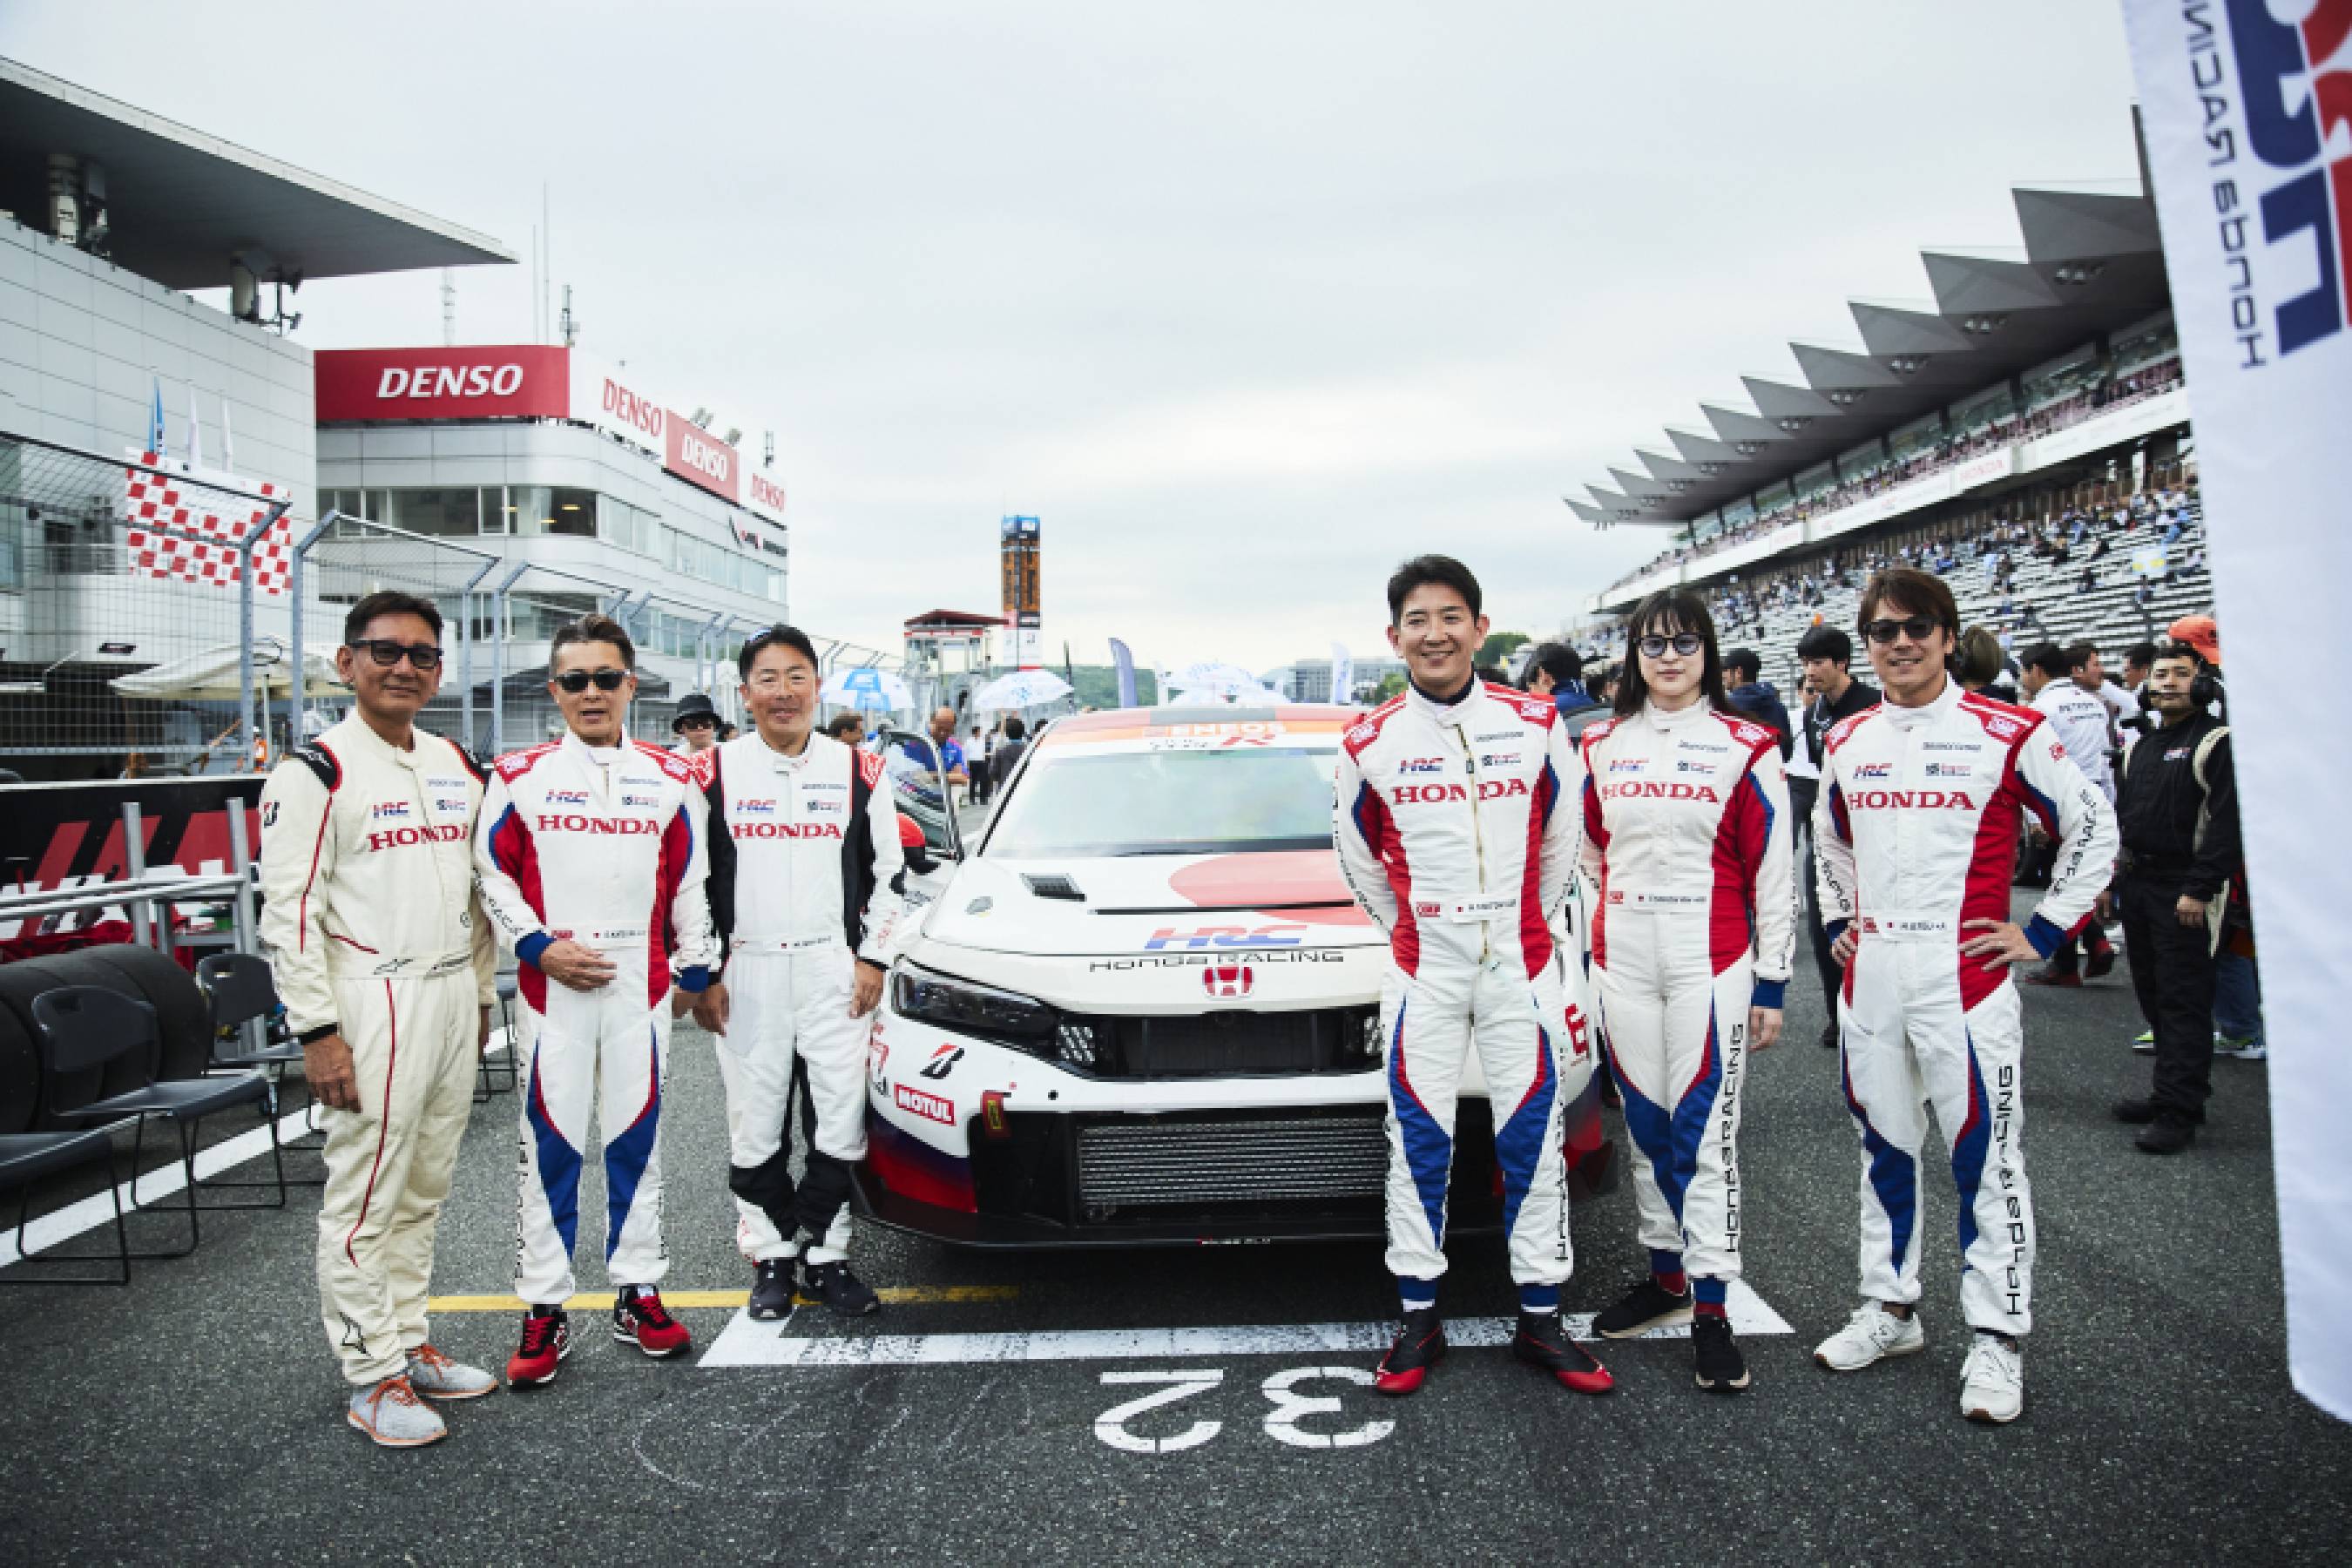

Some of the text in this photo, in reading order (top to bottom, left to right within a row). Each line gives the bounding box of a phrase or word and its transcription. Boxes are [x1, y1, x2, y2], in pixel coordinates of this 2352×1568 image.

[376, 364, 524, 398] DENSO
[603, 375, 662, 437] DENSO
[681, 431, 728, 482] DENSO
[751, 473, 786, 512] DENSO
[1392, 779, 1530, 804] HONDA
[1601, 781, 1720, 803] HONDA
[1848, 791, 1976, 810] HONDA
[537, 814, 659, 835] HONDA
[732, 822, 843, 839] HONDA
[1144, 924, 1307, 949] HRC
[1089, 950, 1344, 972] Honda RACING
[899, 1089, 951, 1122] MOTUL
